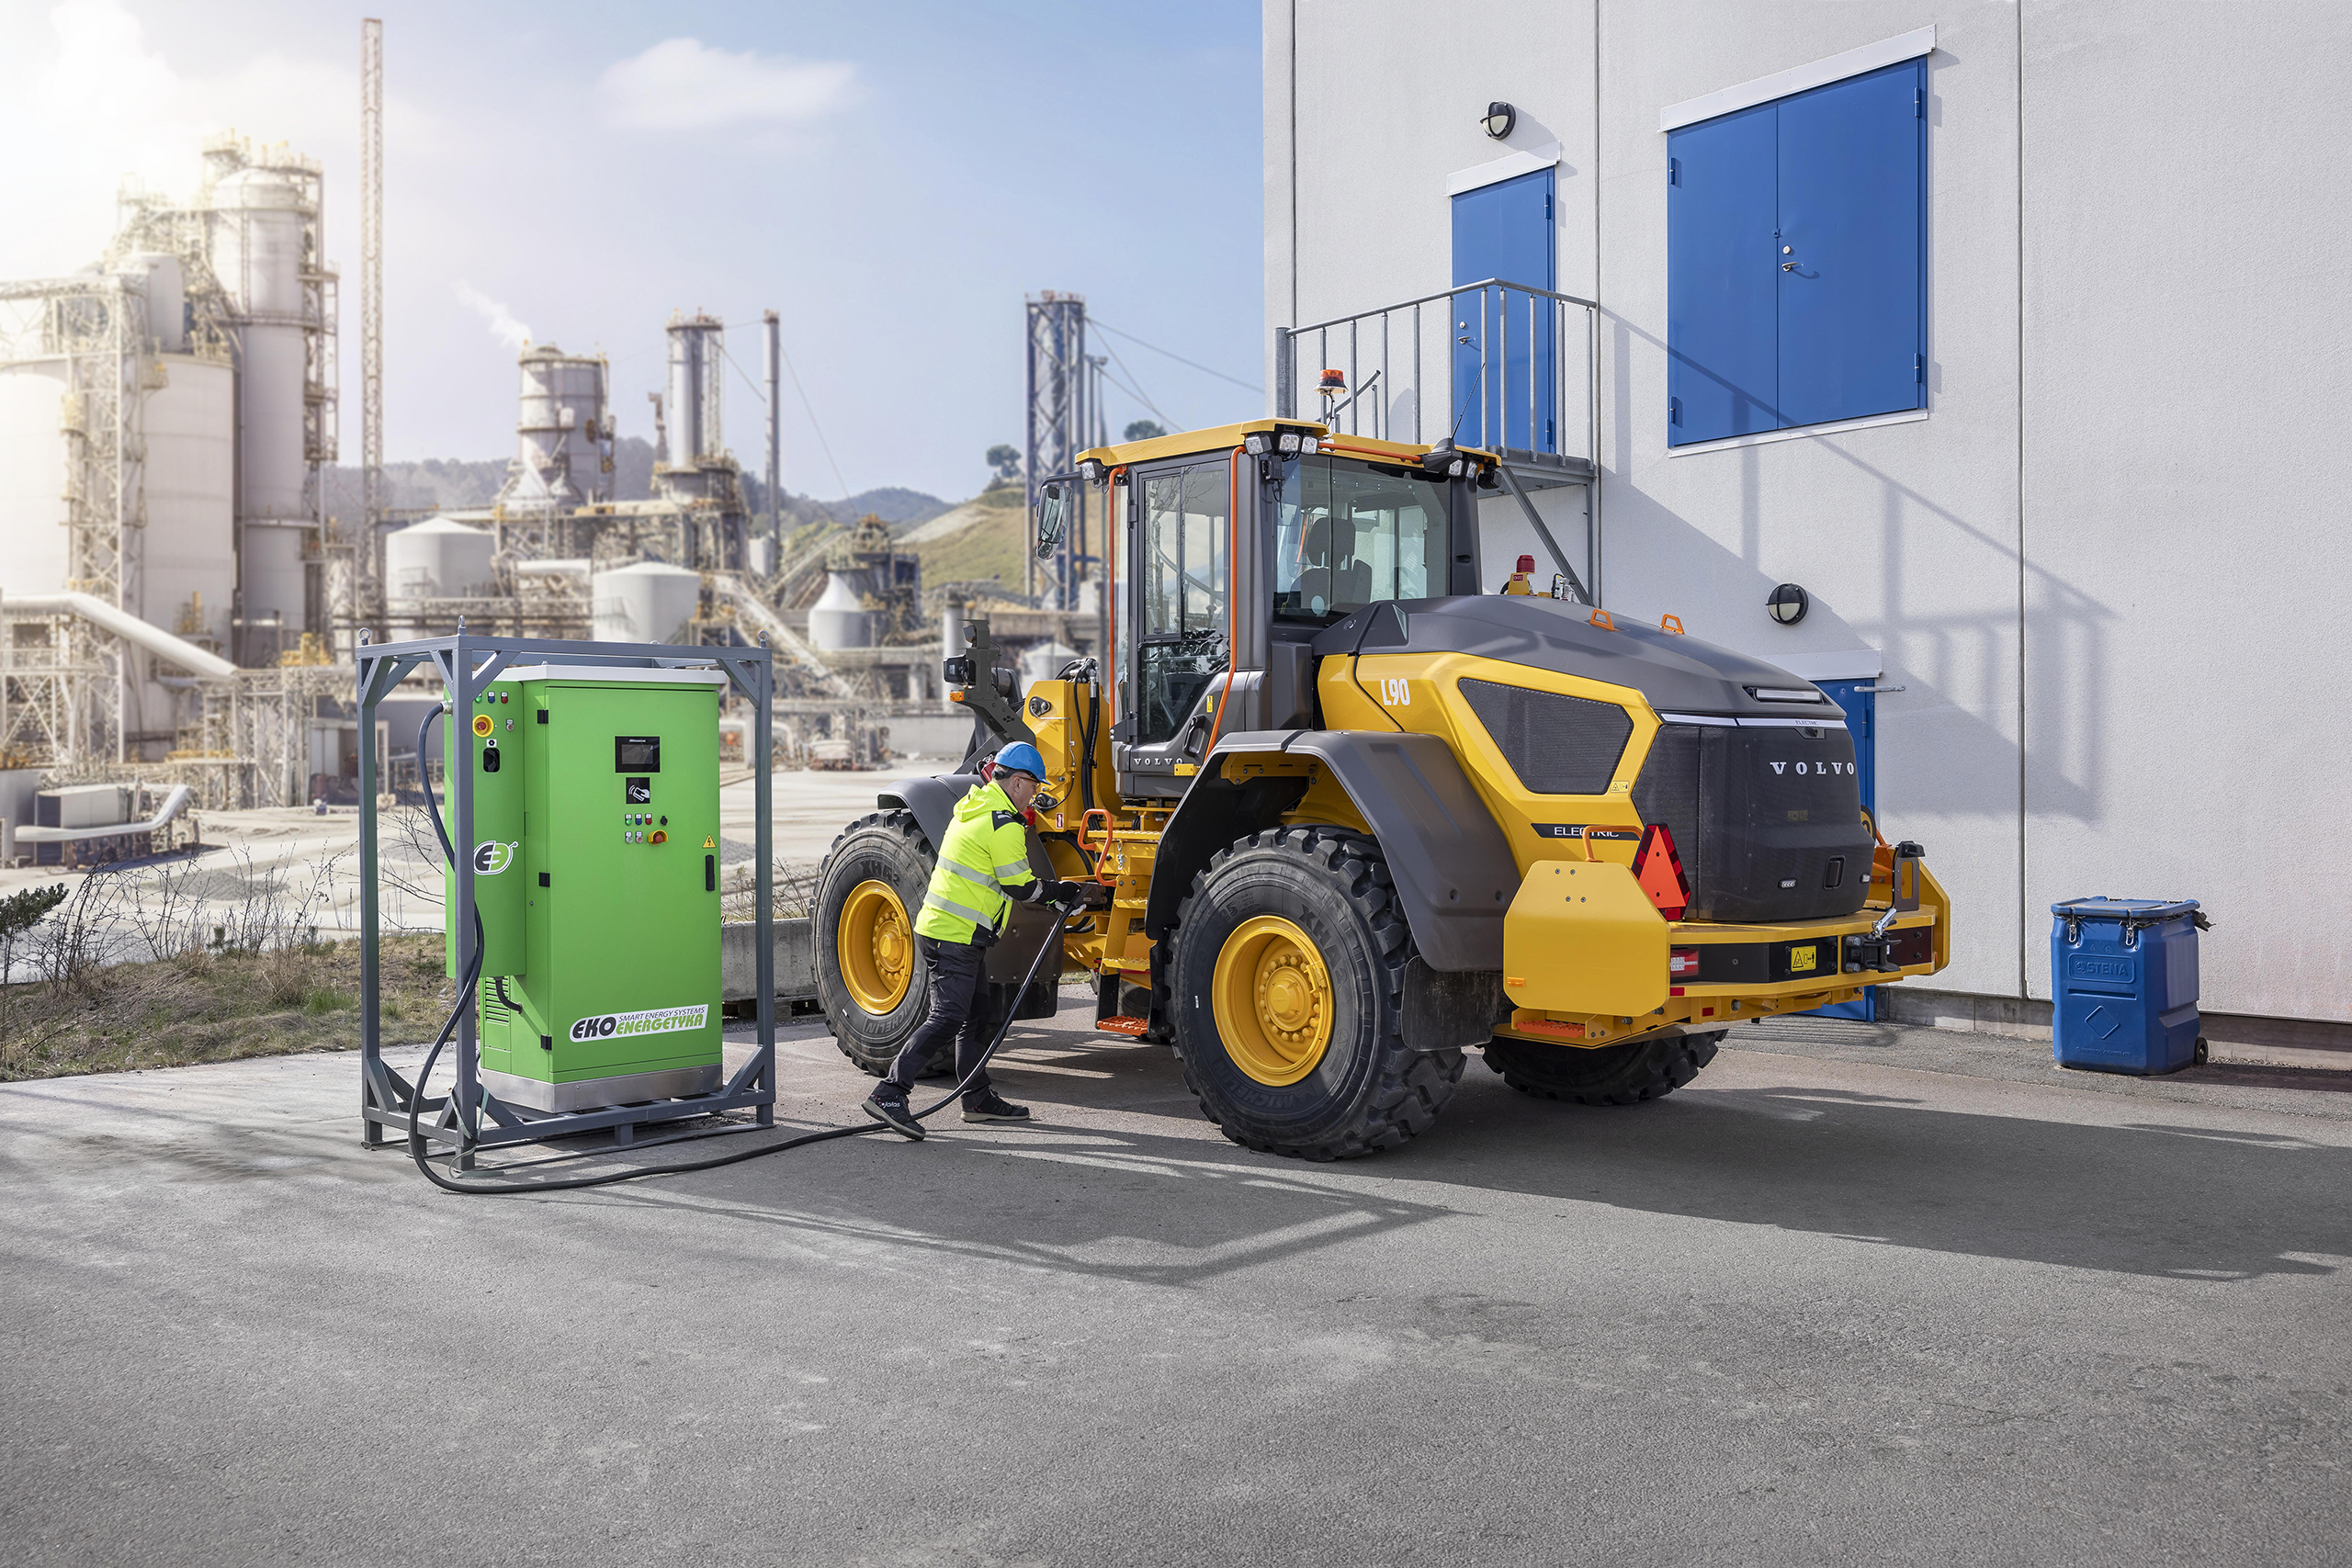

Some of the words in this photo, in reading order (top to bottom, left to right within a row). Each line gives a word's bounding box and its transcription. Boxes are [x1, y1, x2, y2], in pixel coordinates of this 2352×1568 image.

[1380, 678, 1411, 705] L90
[1134, 757, 1183, 765] VOLVO
[1770, 761, 1855, 775] VOLVO
[2086, 962, 2129, 976] STENA
[618, 1012, 645, 1022] SMART
[644, 1010, 674, 1020] ENERGY
[673, 1006, 706, 1016] SYSTEMS
[572, 1016, 616, 1039] EKO
[616, 1013, 704, 1034] ENERGETYKA
